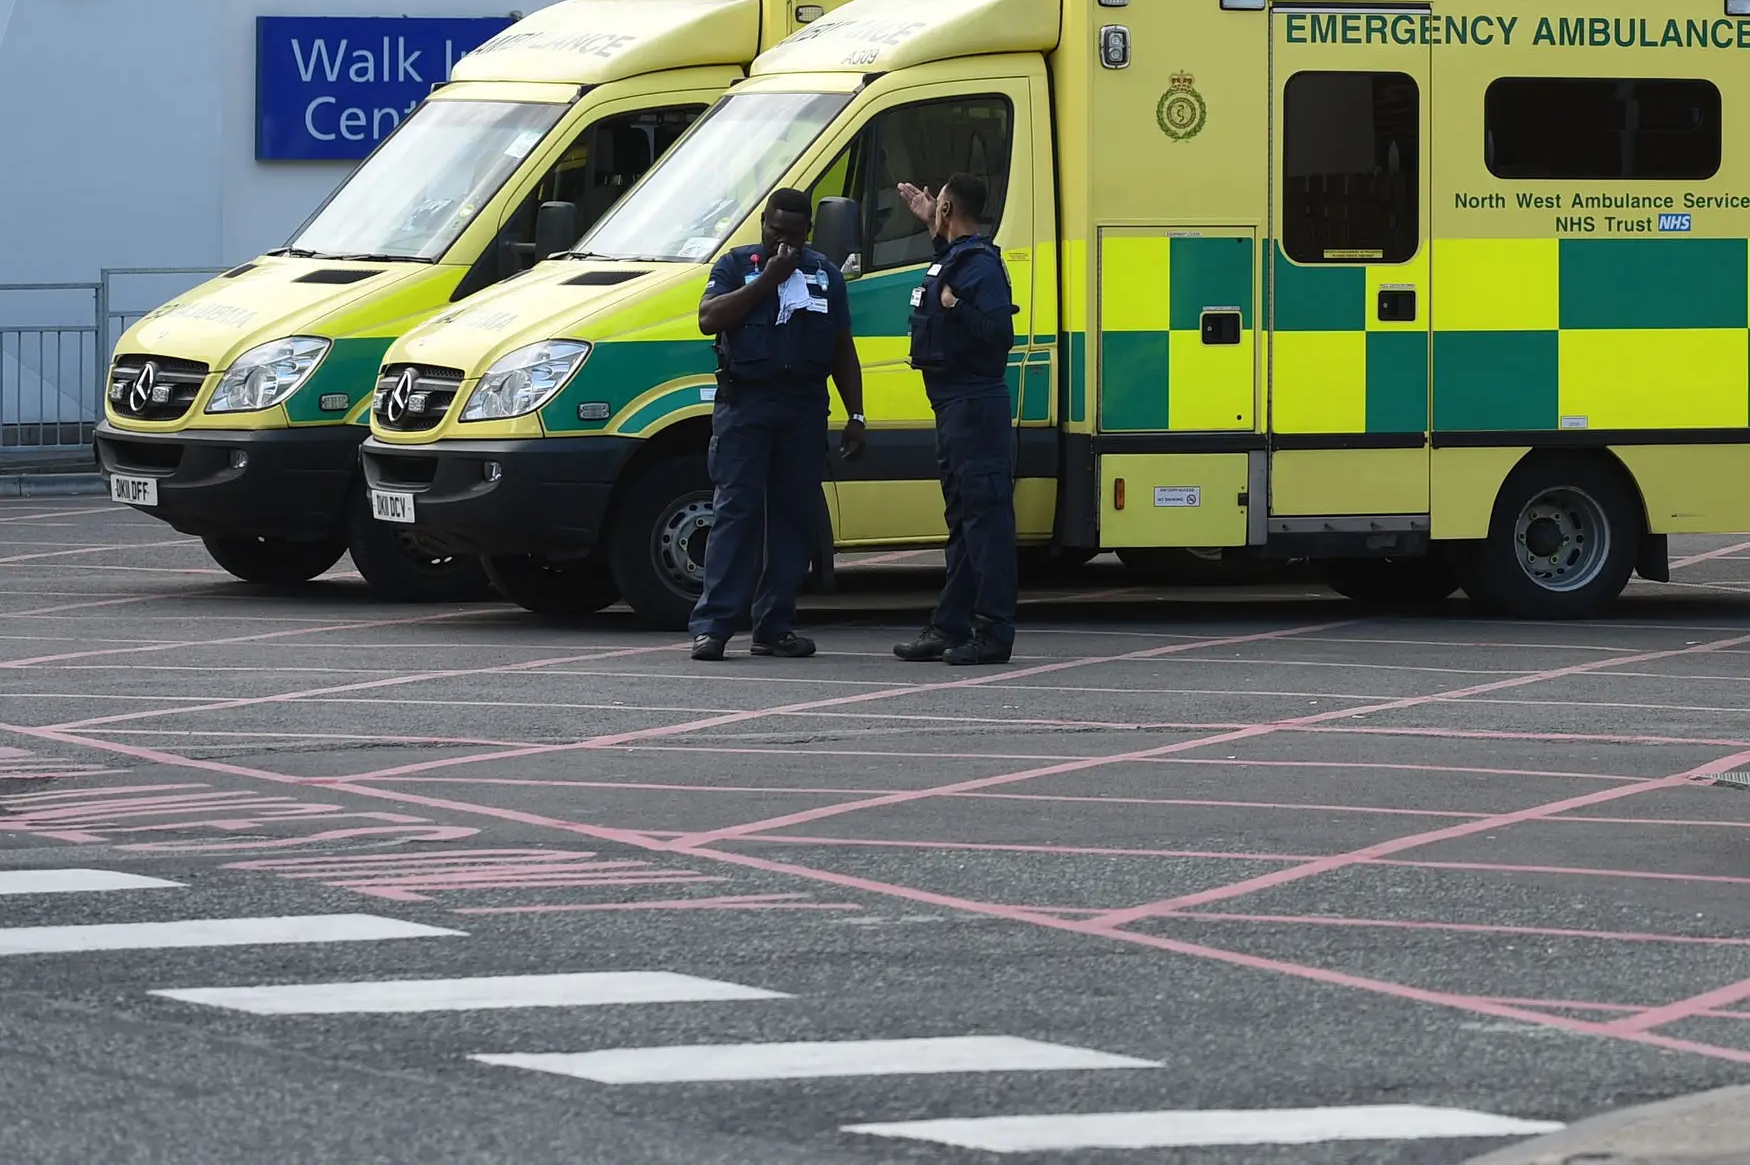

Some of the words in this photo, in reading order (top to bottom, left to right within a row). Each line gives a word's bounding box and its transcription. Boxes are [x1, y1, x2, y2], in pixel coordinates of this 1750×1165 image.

[1285, 14, 1518, 46] EMERGENCY
[290, 36, 423, 82] Walk
[304, 96, 417, 141] Cen
[1455, 193, 1506, 208] North
[1516, 193, 1562, 208] West
[1571, 192, 1674, 209] Ambulance
[1683, 192, 1750, 209] Service
[1555, 216, 1595, 232] NHS
[1604, 216, 1652, 232] Trust
[1659, 214, 1691, 230] NHS
[131, 480, 149, 502] DFF
[390, 496, 405, 518] DCV
